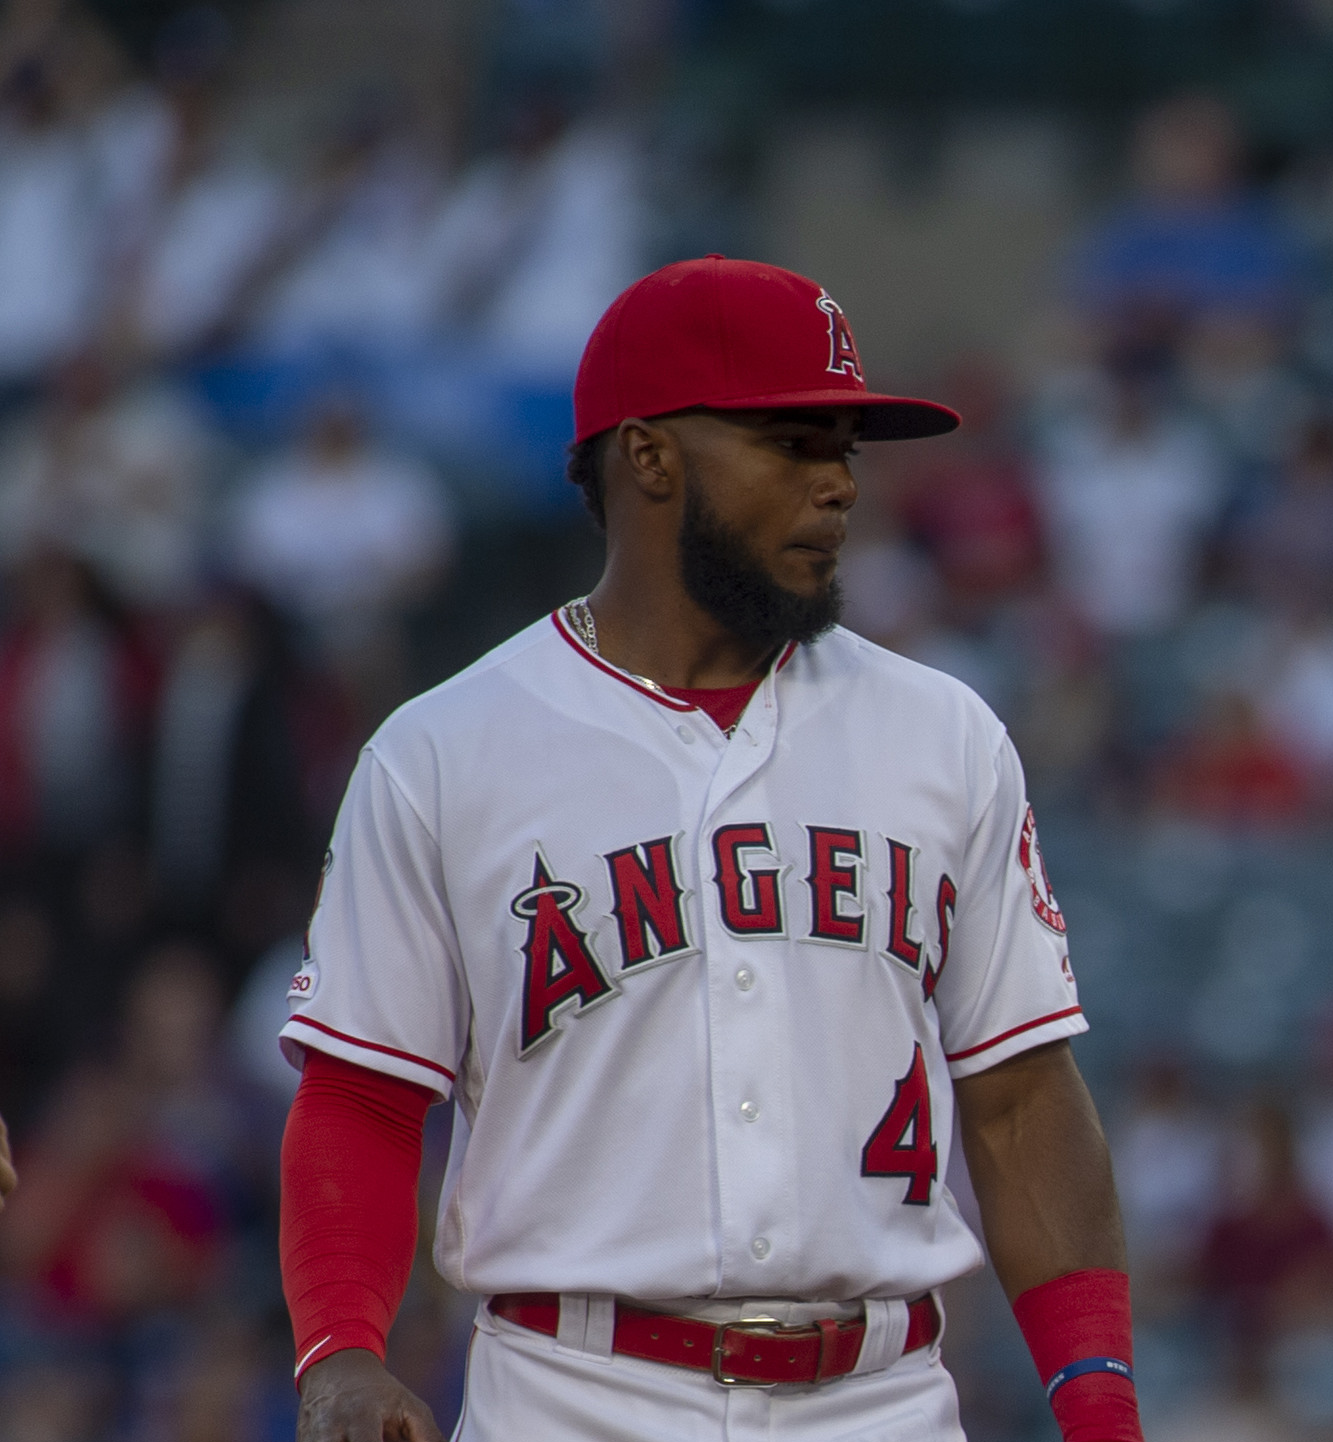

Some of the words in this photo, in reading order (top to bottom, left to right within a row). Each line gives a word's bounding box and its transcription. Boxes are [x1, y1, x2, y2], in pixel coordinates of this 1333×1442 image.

[816, 287, 864, 383] A
[291, 975, 311, 991] 50
[511, 822, 957, 1061] ANGELS
[860, 1041, 939, 1206] 4
